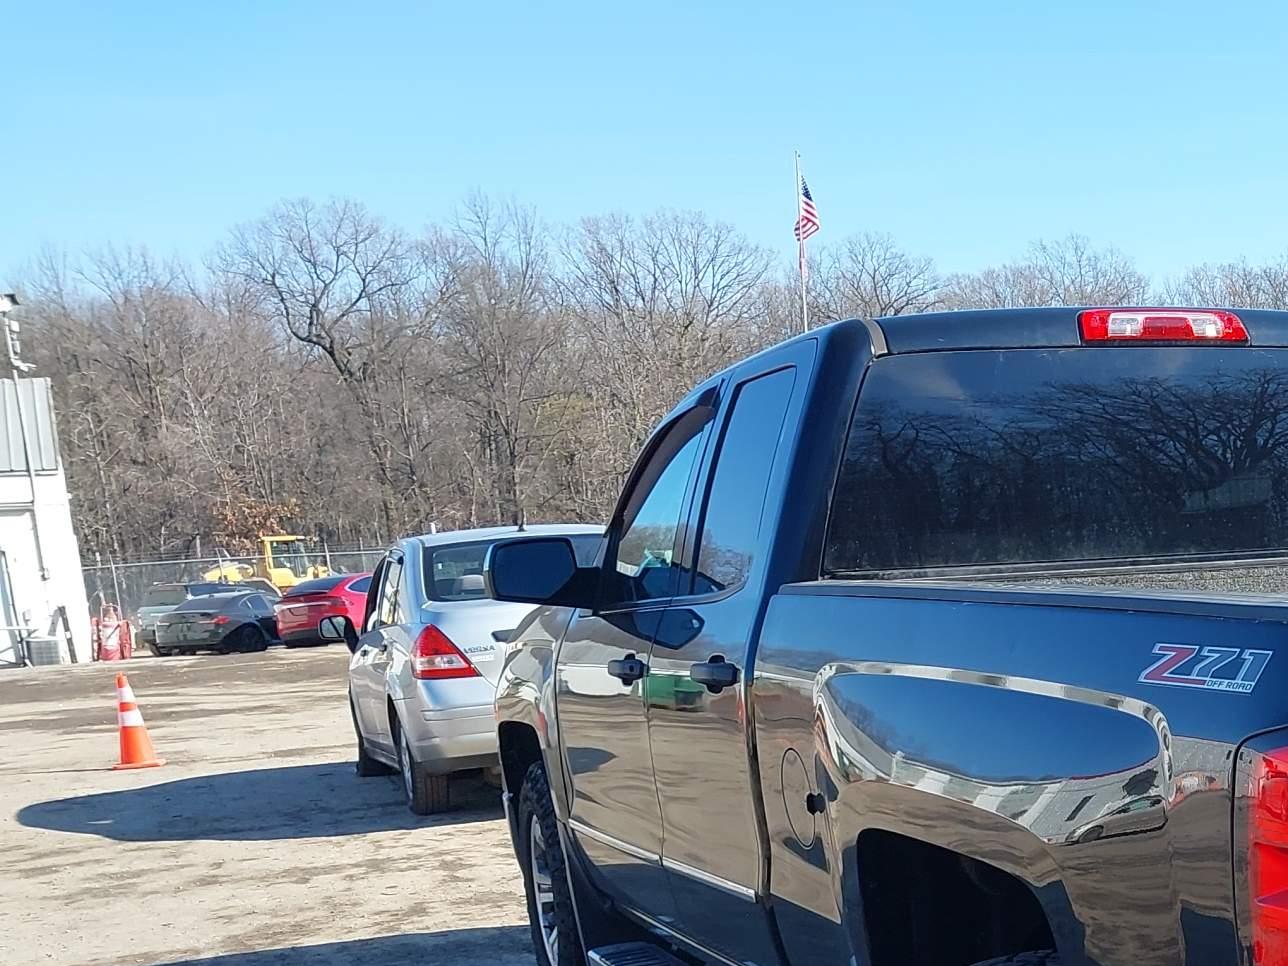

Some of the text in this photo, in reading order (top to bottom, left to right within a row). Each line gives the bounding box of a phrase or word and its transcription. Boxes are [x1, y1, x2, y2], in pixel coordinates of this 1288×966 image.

[1137, 643, 1273, 686] Z71
[1206, 679, 1253, 691] OFF ROAD
